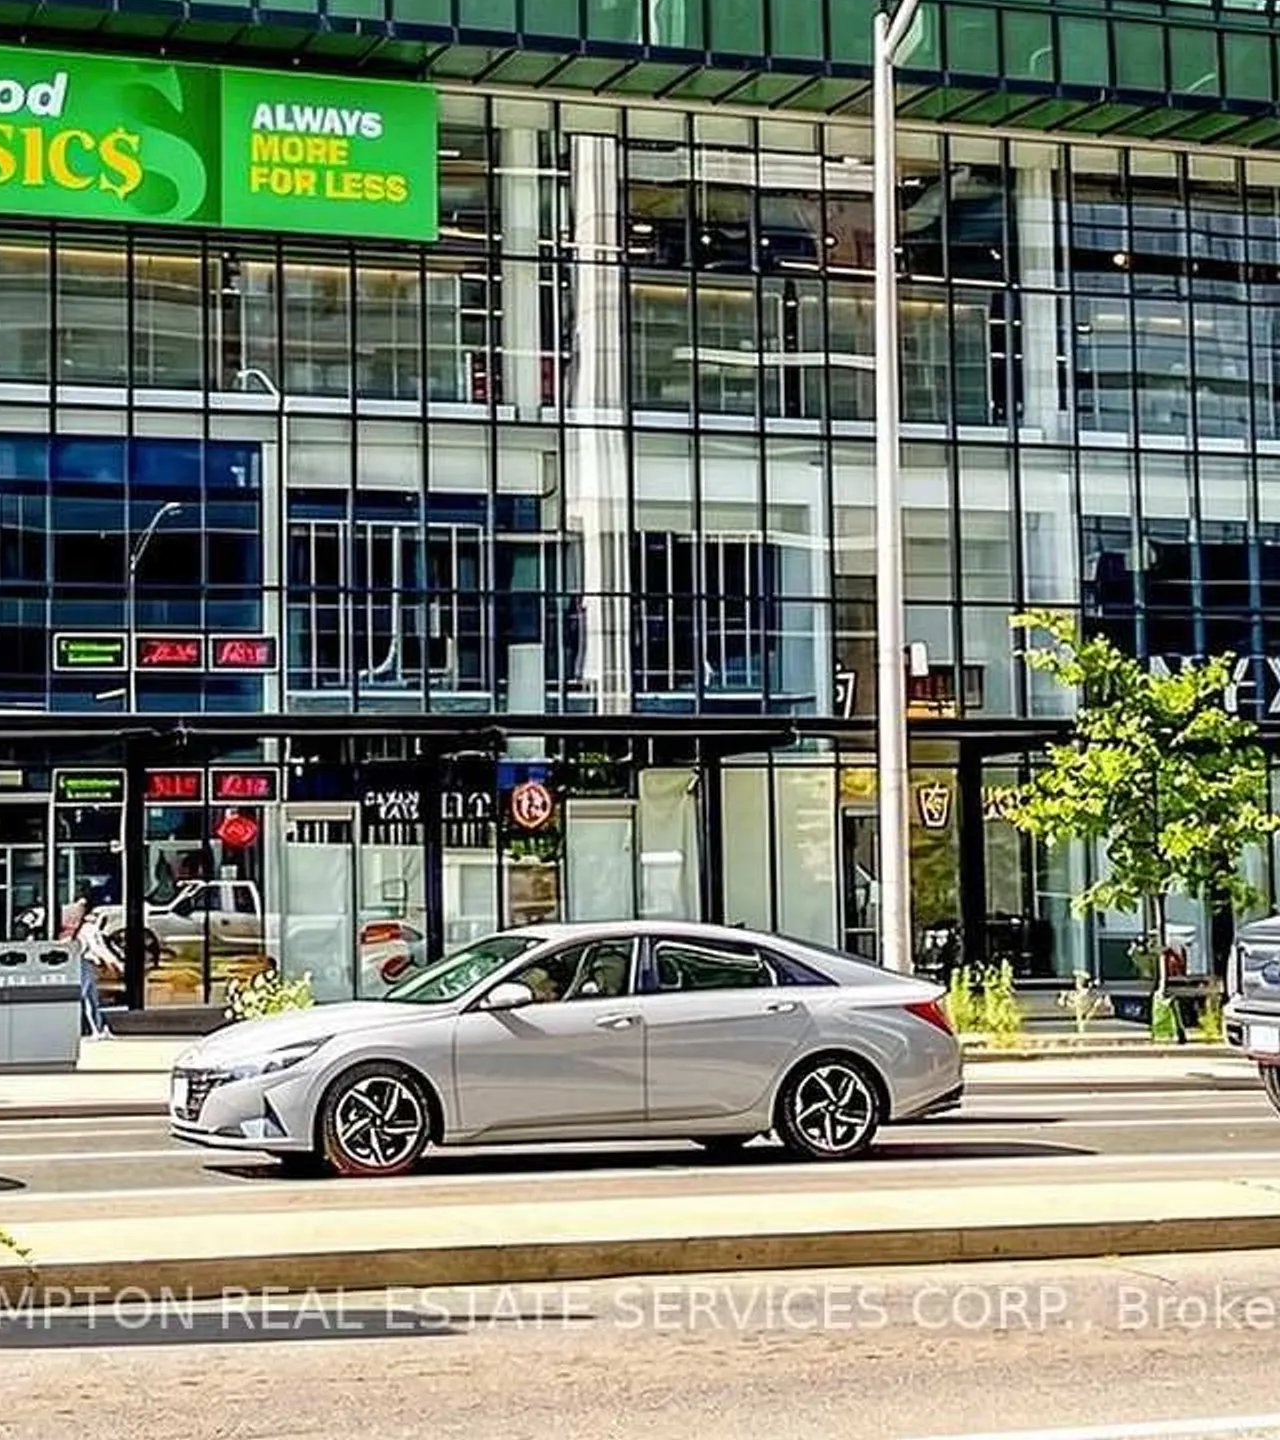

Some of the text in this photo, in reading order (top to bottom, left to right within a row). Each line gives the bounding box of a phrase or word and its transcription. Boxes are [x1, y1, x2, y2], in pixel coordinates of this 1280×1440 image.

[252, 103, 383, 139] ALWAYS
[252, 133, 350, 166] MORE
[250, 165, 409, 203] FOR LESS
